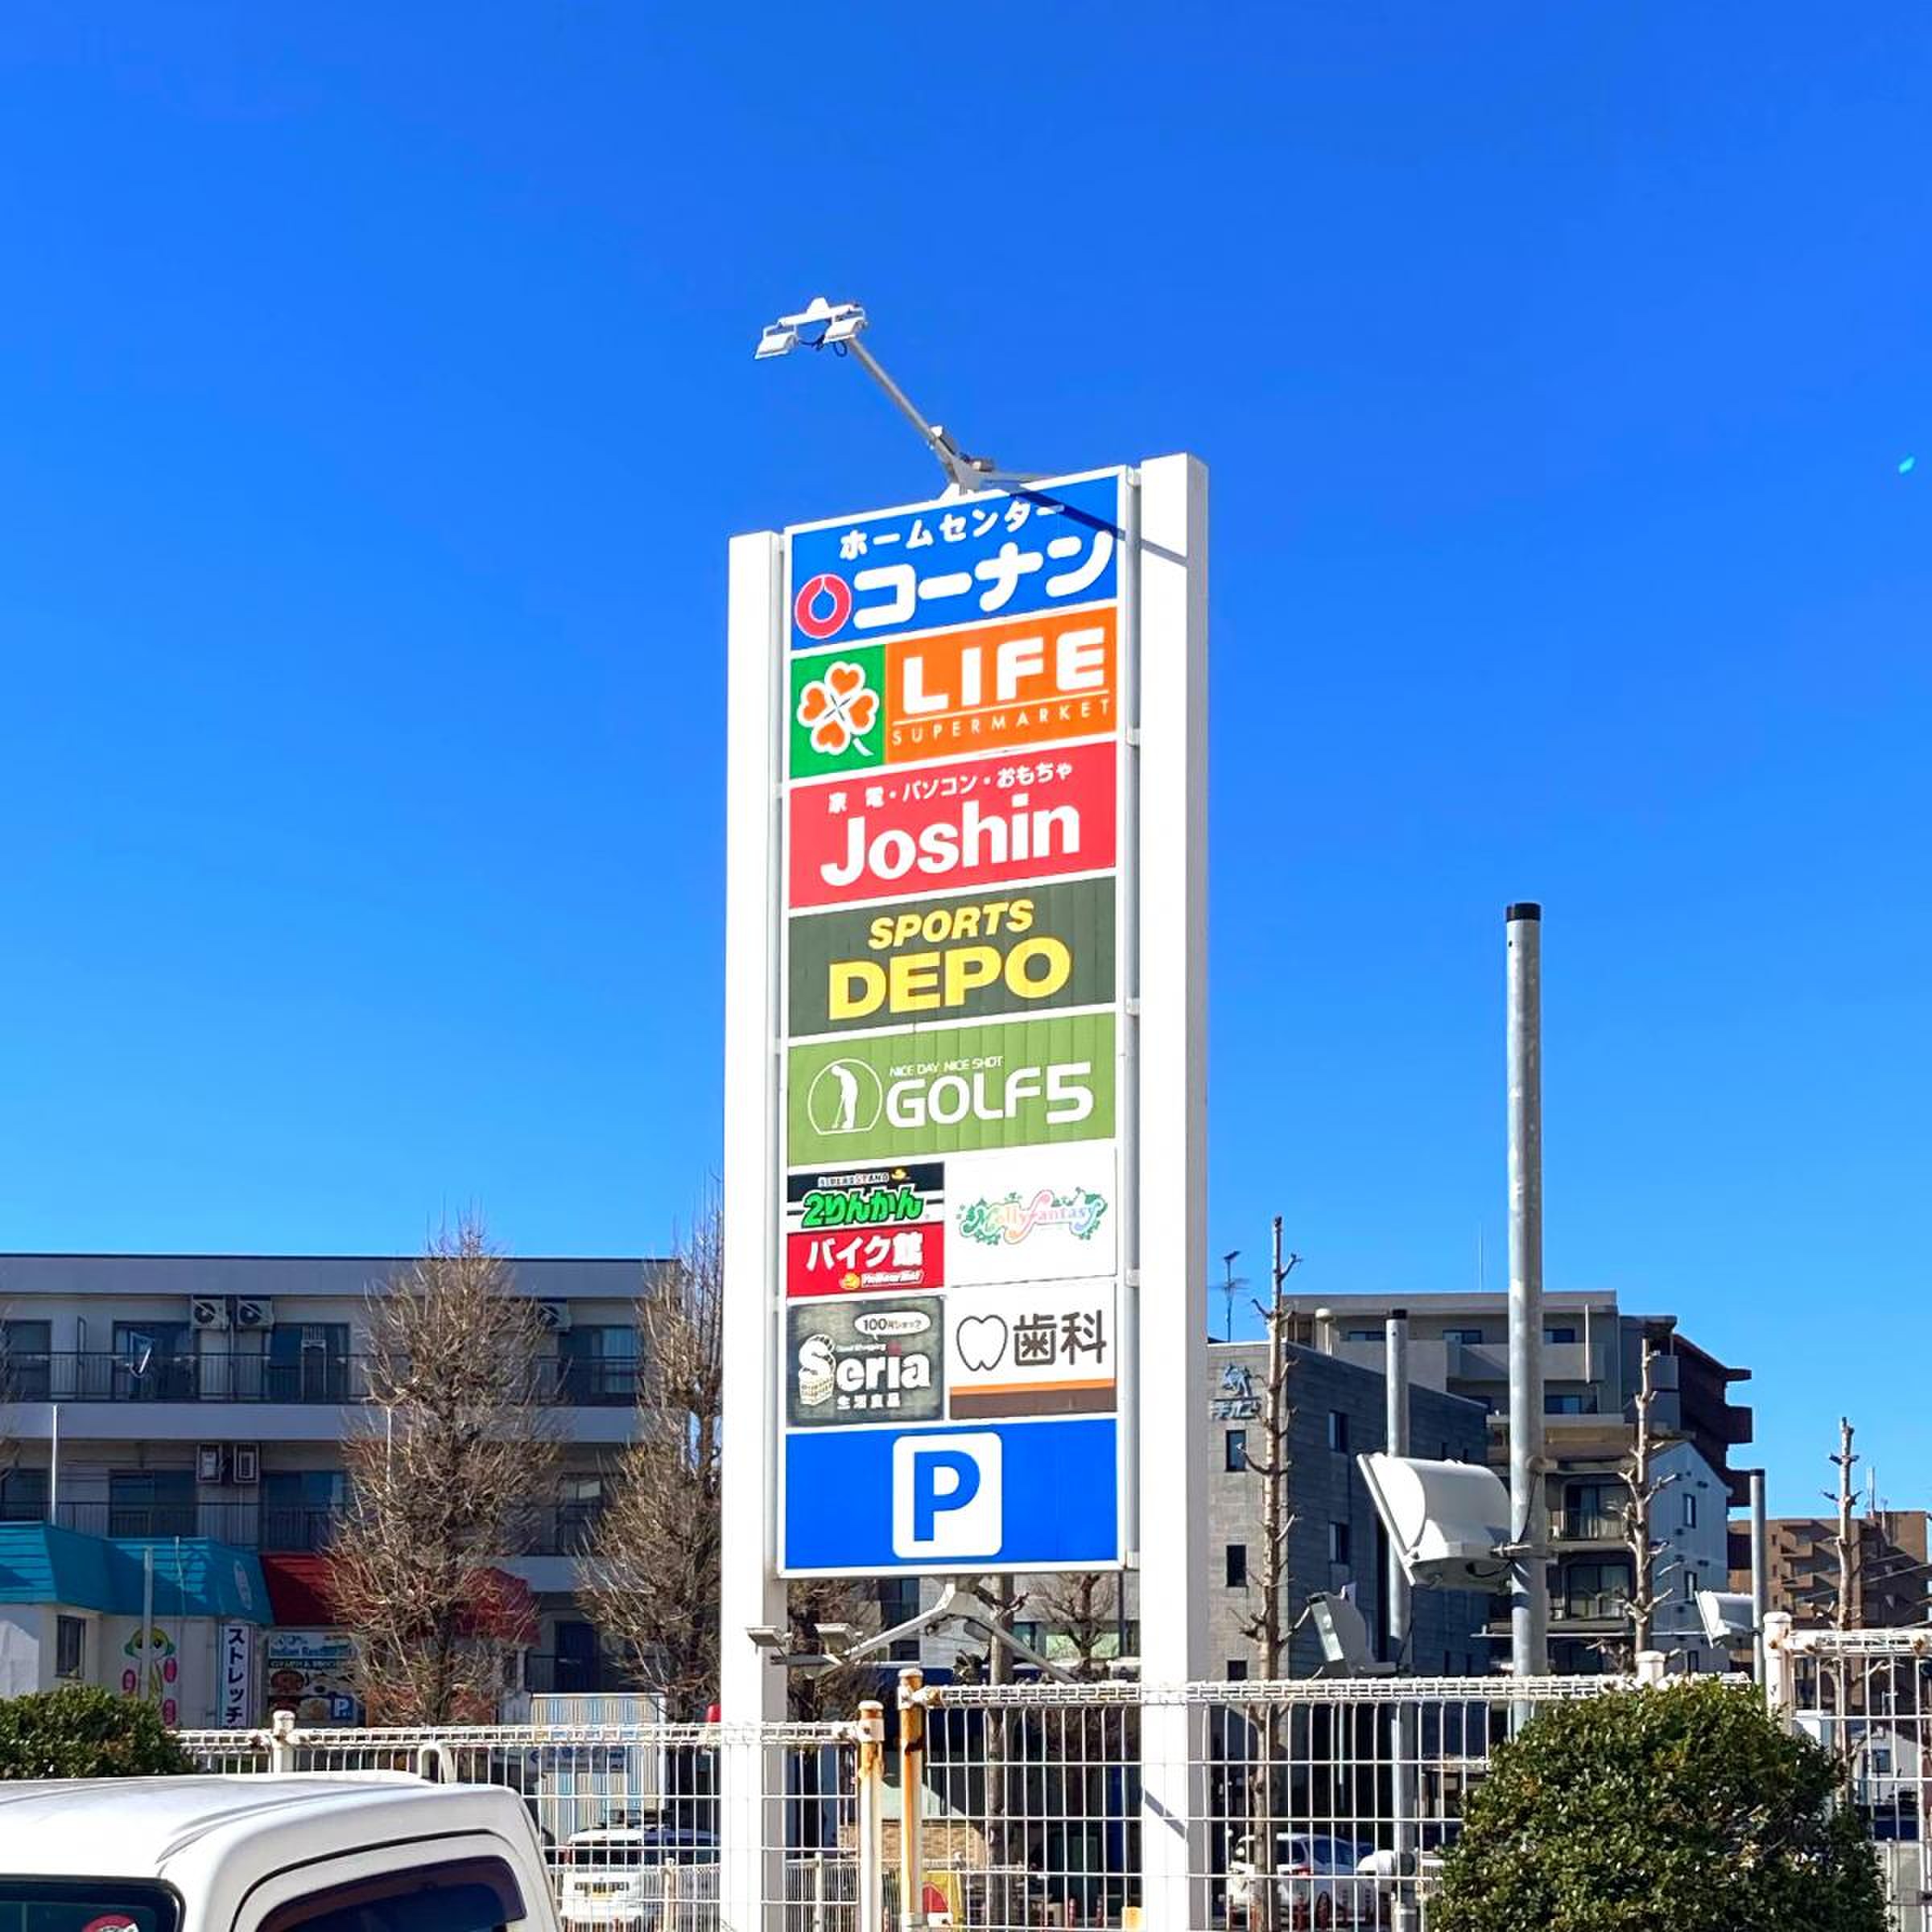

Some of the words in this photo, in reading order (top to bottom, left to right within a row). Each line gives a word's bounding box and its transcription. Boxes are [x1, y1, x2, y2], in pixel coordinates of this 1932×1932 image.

[840, 501, 1065, 560] ホームセンター
[853, 530, 1113, 630] コーナン
[902, 626, 1105, 715] LIFE
[892, 698, 1111, 746] SUPERMARKET
[820, 794, 1080, 886] Joshin
[868, 898, 1035, 950] SPORTS
[828, 937, 1072, 1021] DEPO
[886, 1061, 1095, 1128] GOLF5
[889, 1064, 914, 1077] NICE
[916, 1061, 940, 1075] DAY
[943, 1058, 970, 1072] NICE
[972, 1055, 1004, 1070] SHOT
[800, 1186, 925, 1228] 2りんかん
[799, 1334, 931, 1402] Seria
[1013, 1309, 1108, 1366] 歯科
[914, 1451, 981, 1542] P
[225, 1628, 246, 1724] ストレッチ
